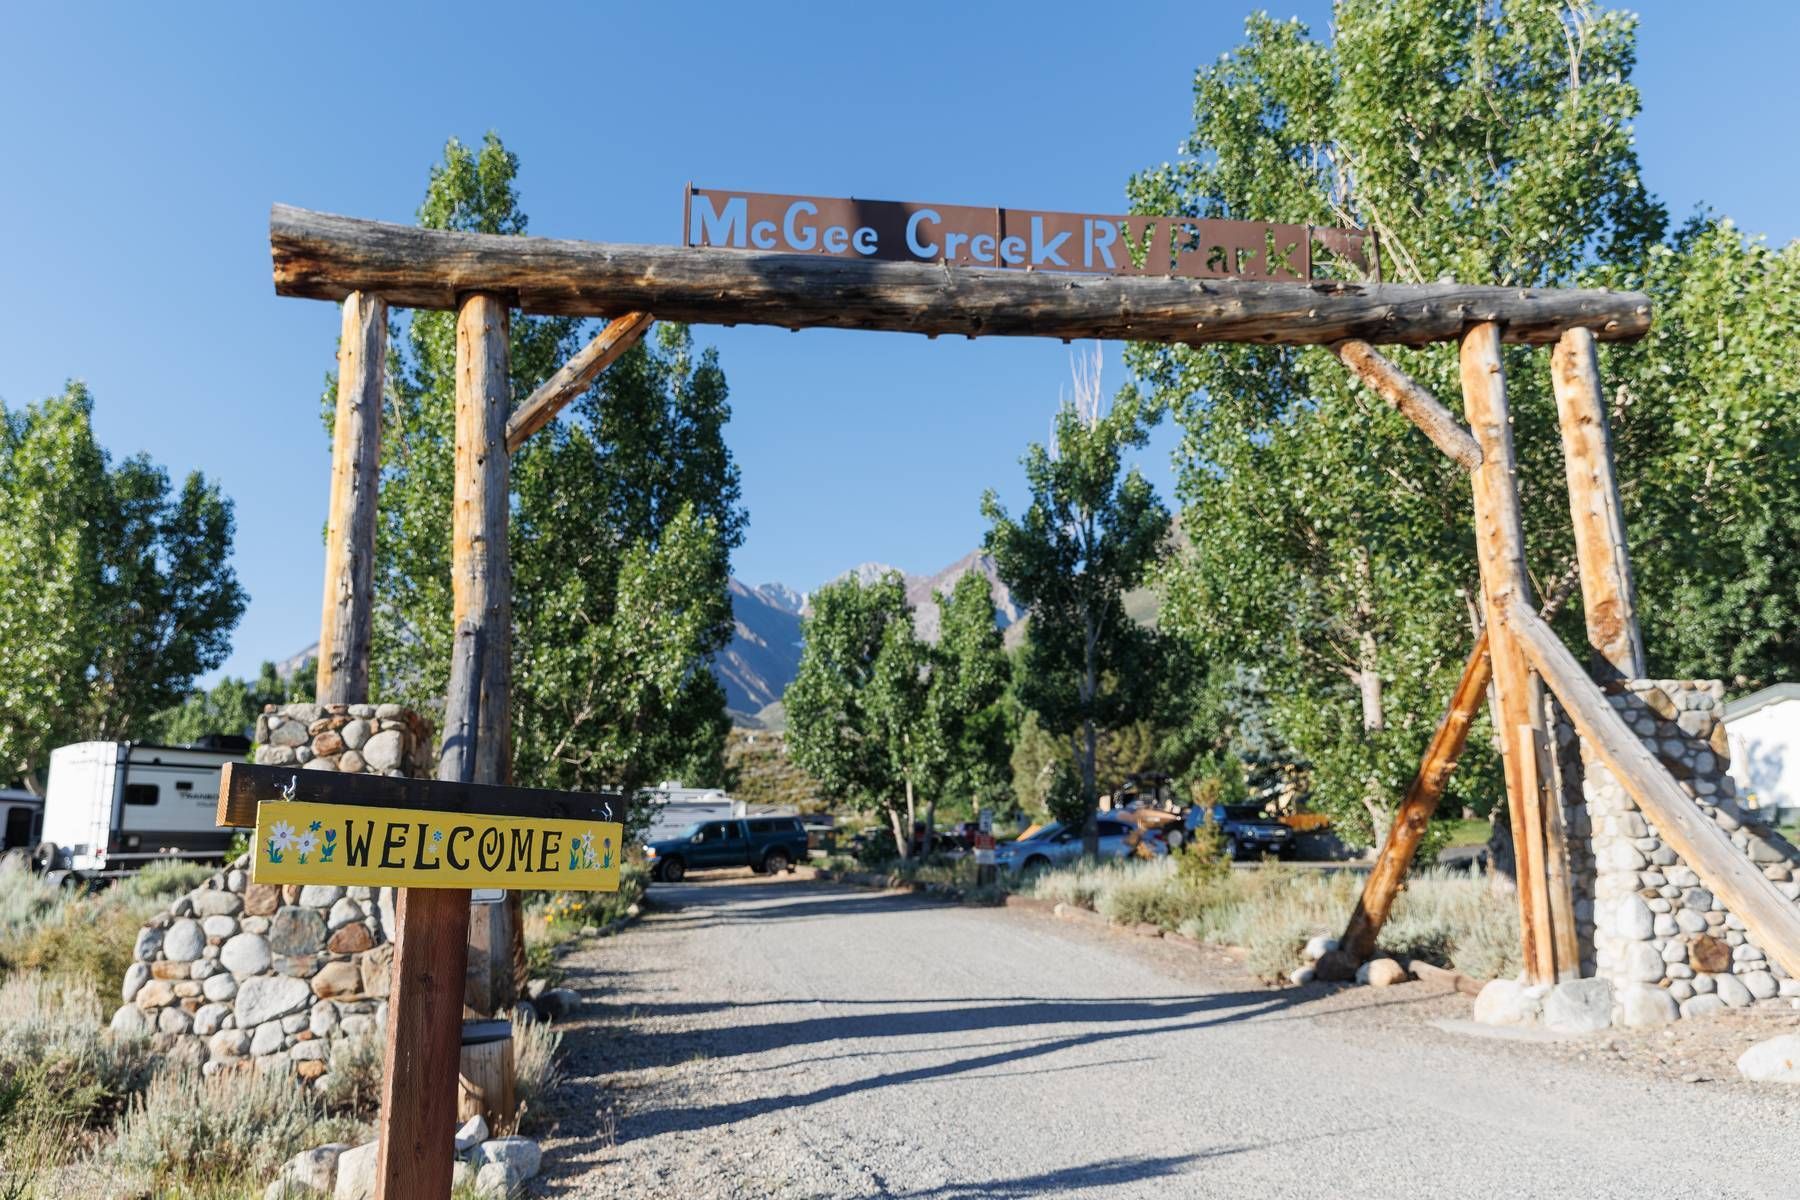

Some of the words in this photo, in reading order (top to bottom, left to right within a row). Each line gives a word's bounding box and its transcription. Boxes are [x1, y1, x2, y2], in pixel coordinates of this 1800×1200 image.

[692, 195, 879, 255] McGee
[905, 209, 1074, 268] Creek
[1083, 217, 1156, 271] RV
[1168, 223, 1304, 277] Park
[345, 820, 562, 873] WELCOME
